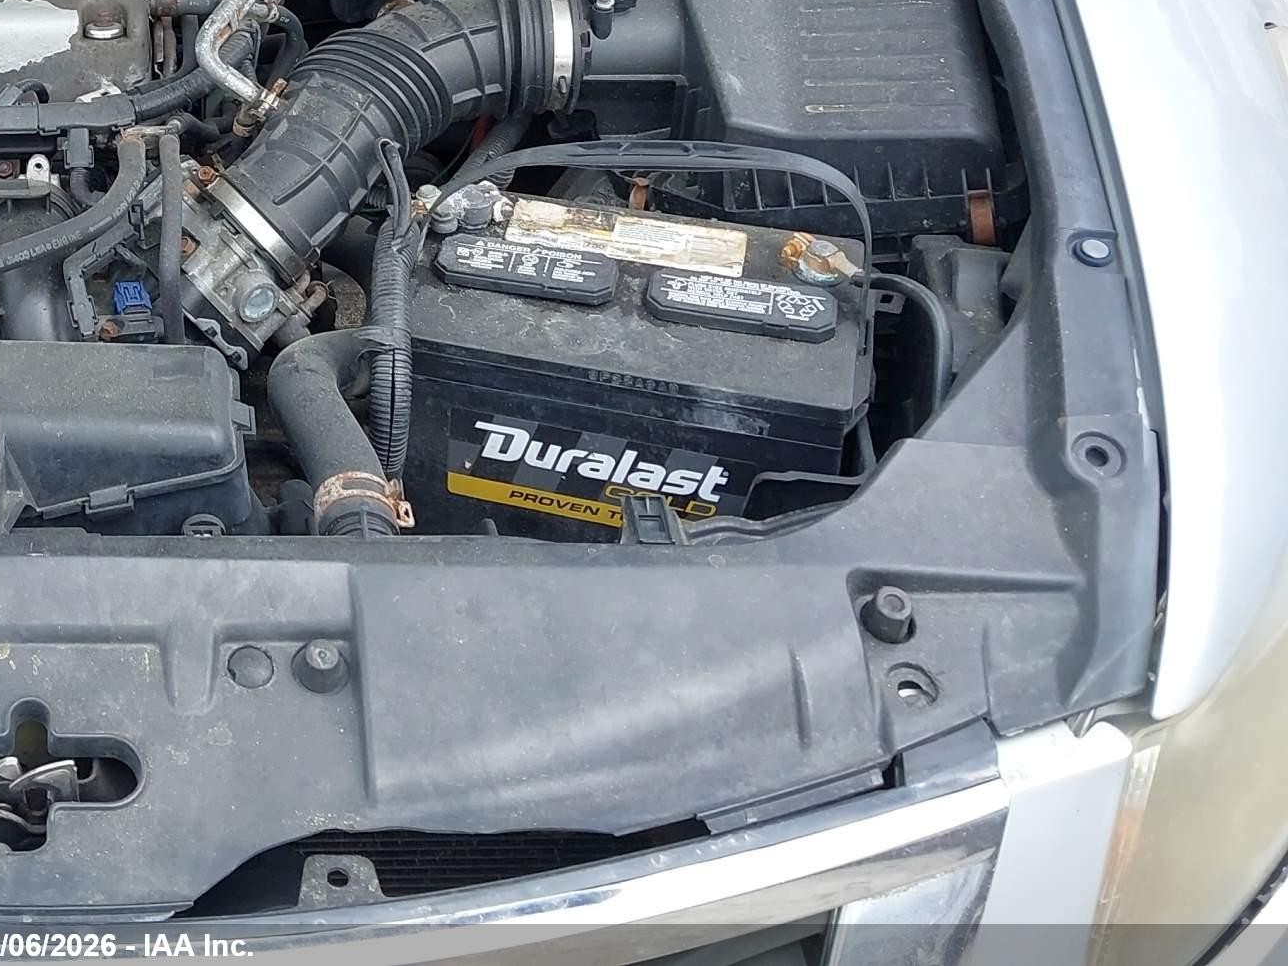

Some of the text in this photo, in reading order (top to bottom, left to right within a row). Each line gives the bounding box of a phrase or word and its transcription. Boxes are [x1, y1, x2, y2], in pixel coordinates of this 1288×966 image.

[487, 242, 531, 254] DANGER
[542, 249, 582, 260] POISON
[474, 421, 729, 503] Duralast
[508, 490, 601, 516] PROVEN
[605, 485, 717, 517] GLD
